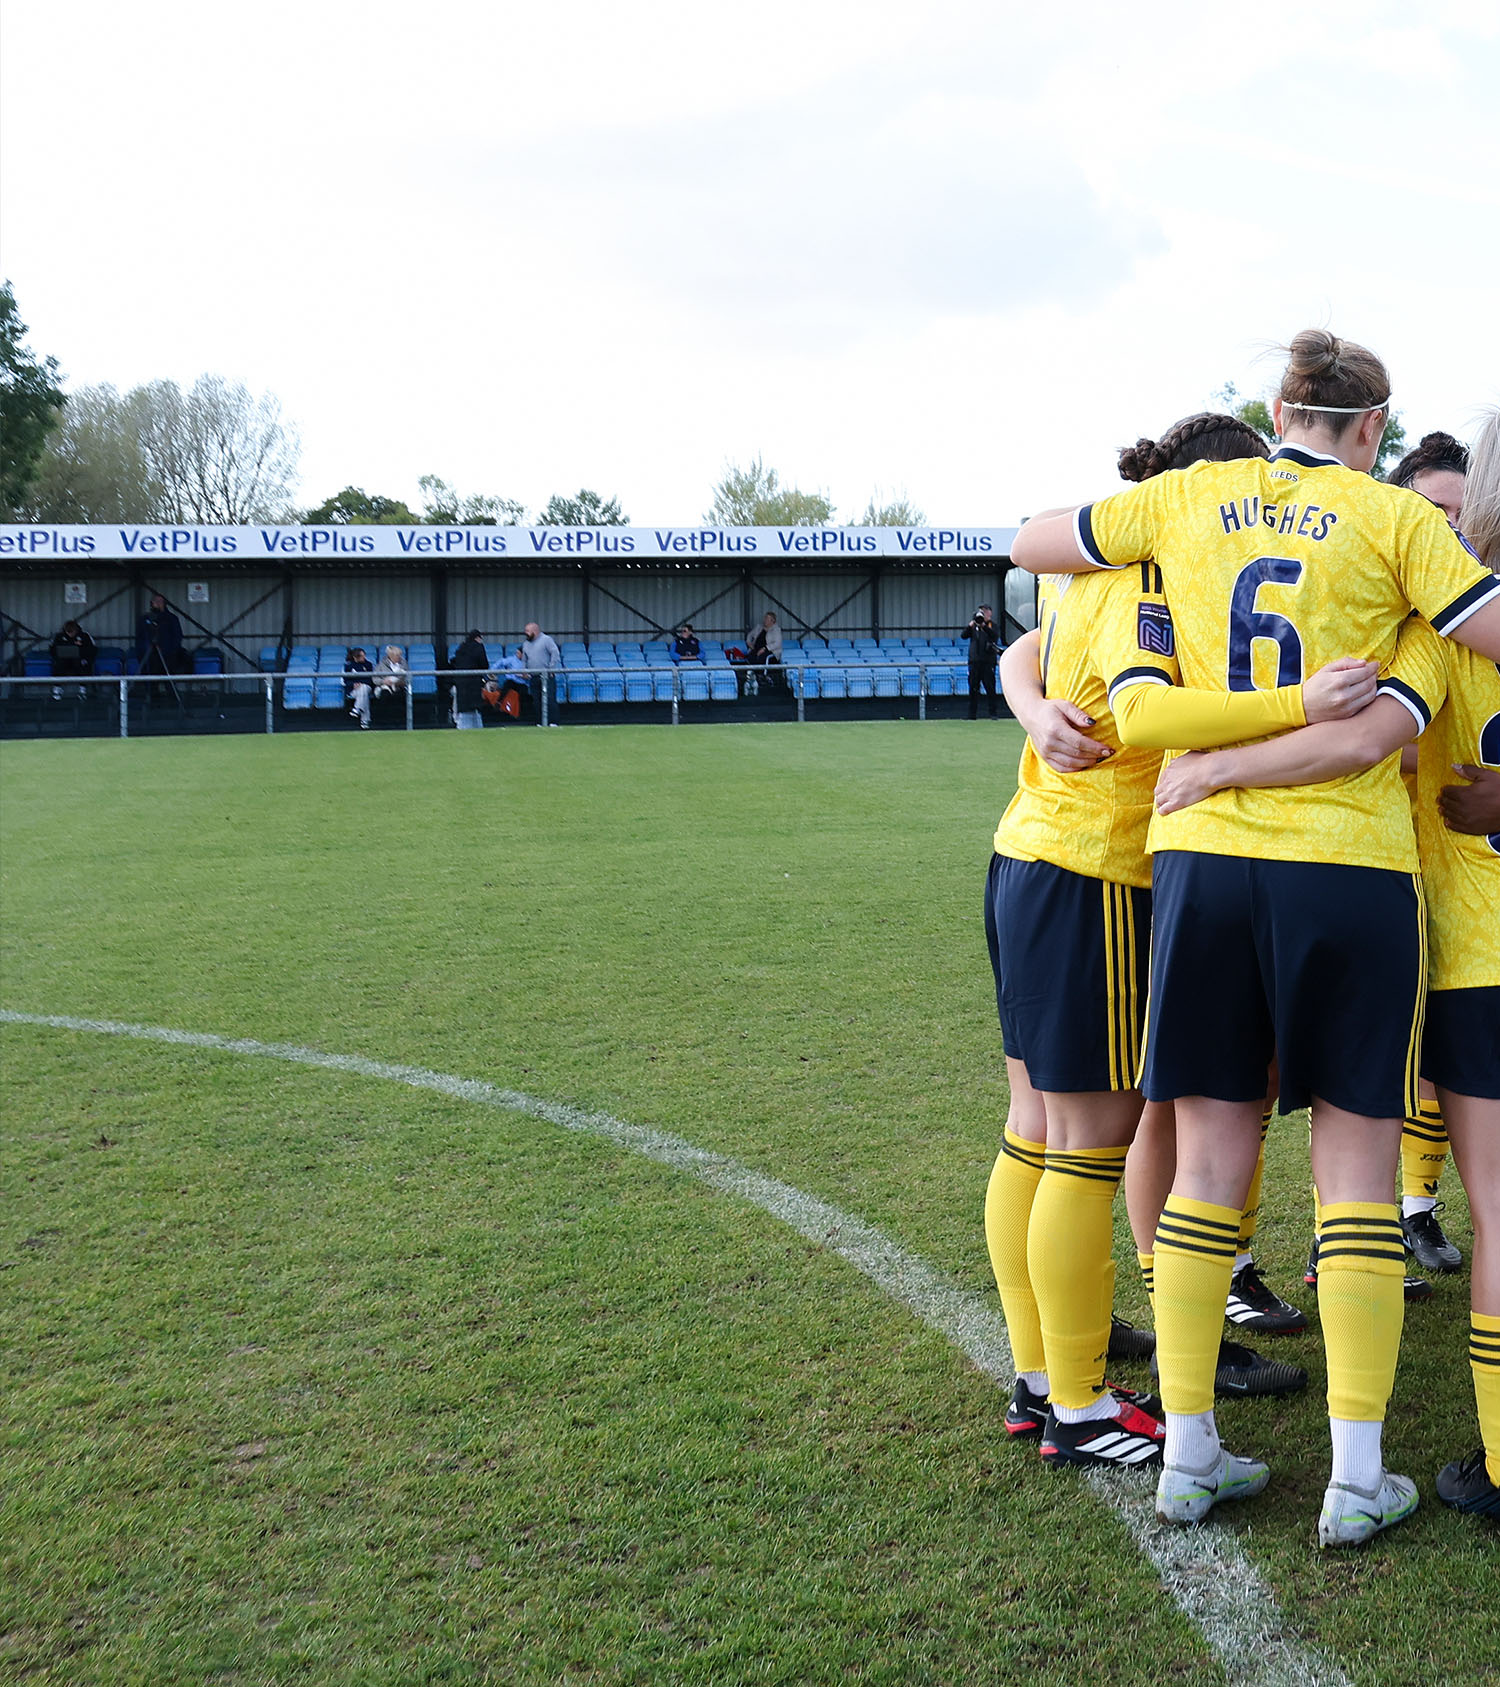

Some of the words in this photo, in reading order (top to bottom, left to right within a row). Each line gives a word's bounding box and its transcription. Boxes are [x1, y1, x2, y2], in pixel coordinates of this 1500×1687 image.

[1270, 471, 1299, 482] LEEDS
[1219, 496, 1338, 541] HUGHES
[0, 531, 95, 552] etPlus
[119, 530, 236, 552] VetPlus
[260, 530, 374, 552] VetPlus
[396, 530, 506, 552] VetPlus
[529, 530, 635, 551] VetPlus
[655, 530, 757, 551] VetPlus
[777, 530, 876, 551] VetPlus
[896, 530, 992, 551] VetPlus
[1226, 556, 1304, 692] 6
